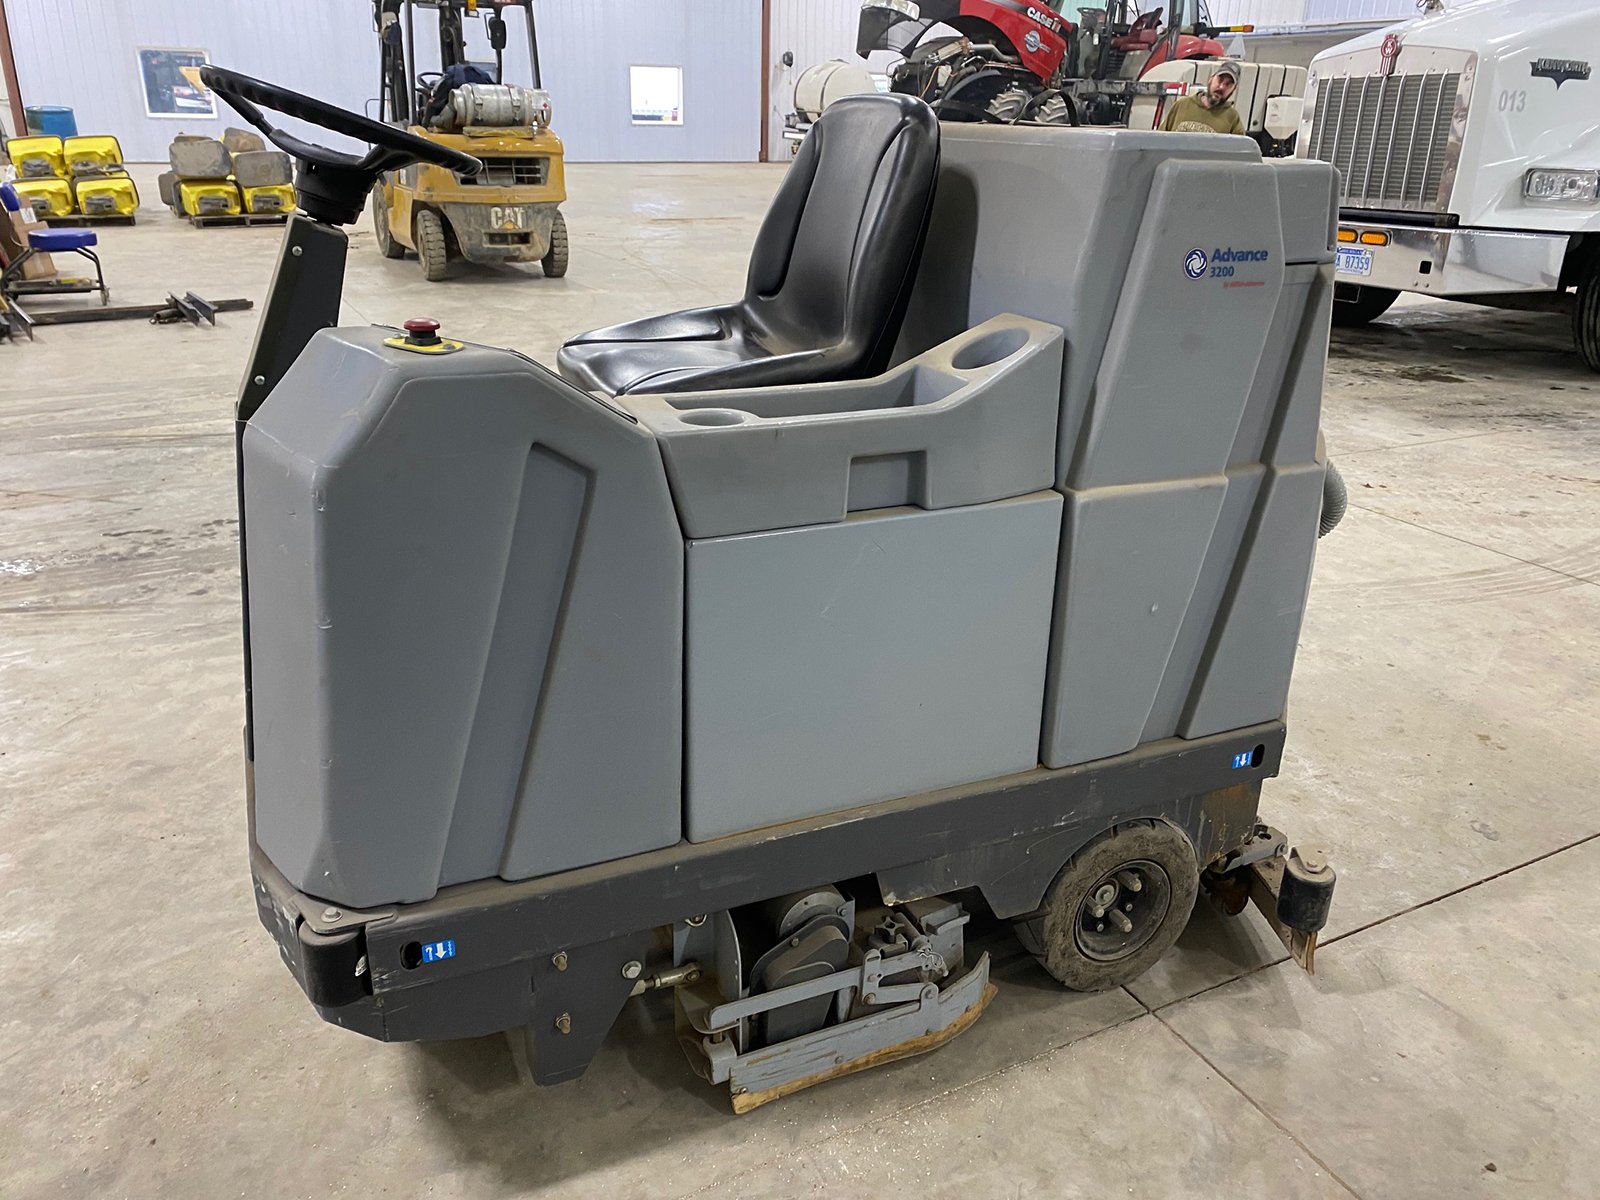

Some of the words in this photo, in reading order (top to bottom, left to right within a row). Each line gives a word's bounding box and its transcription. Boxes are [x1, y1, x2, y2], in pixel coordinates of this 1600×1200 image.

[1027, 6, 1053, 29] CASE
[1499, 90, 1526, 112] 013
[491, 206, 525, 229] CAT
[1211, 247, 1268, 262] Advance
[1345, 256, 1370, 270] 87359
[1210, 266, 1235, 278] 3200
